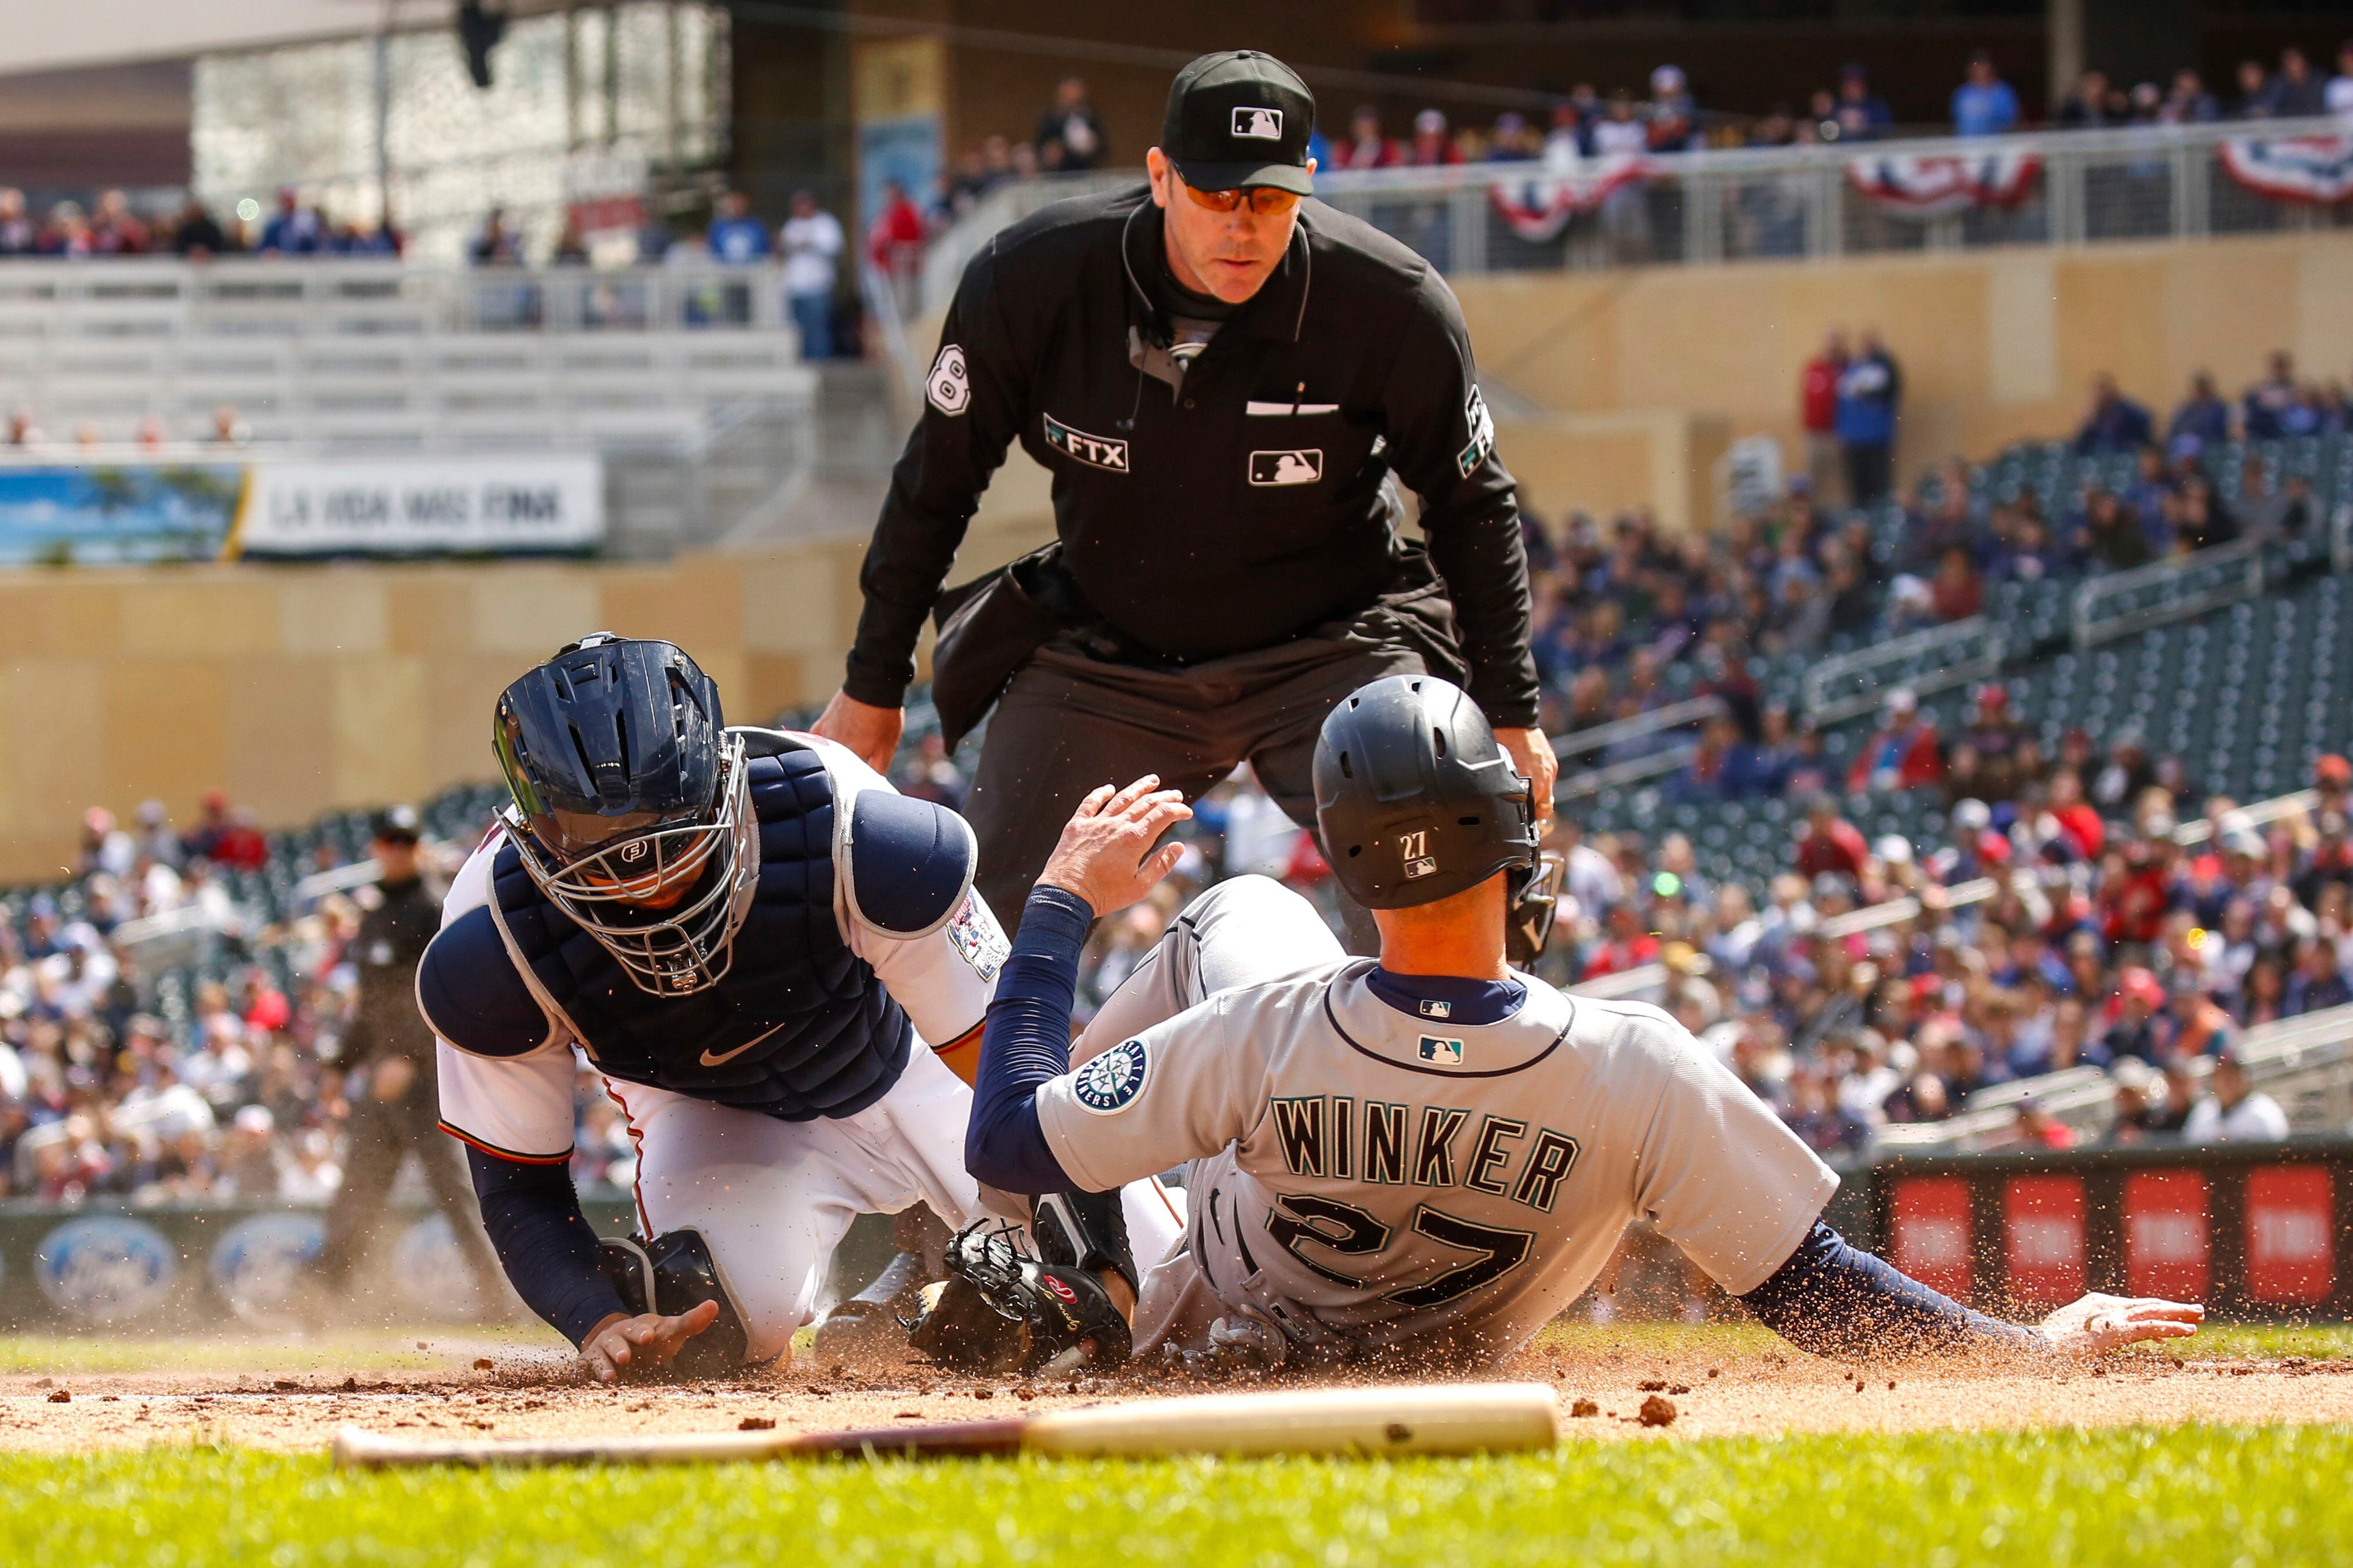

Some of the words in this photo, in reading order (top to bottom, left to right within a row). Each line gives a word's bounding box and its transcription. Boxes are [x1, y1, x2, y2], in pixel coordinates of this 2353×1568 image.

[926, 344, 971, 417] 8
[1067, 432, 1125, 468] FTX
[1399, 831, 1426, 860] 27
[1118, 1042, 1143, 1096] SEATTLE
[1270, 1094, 1581, 1214] WINKER
[1265, 1192, 1538, 1309] 27
